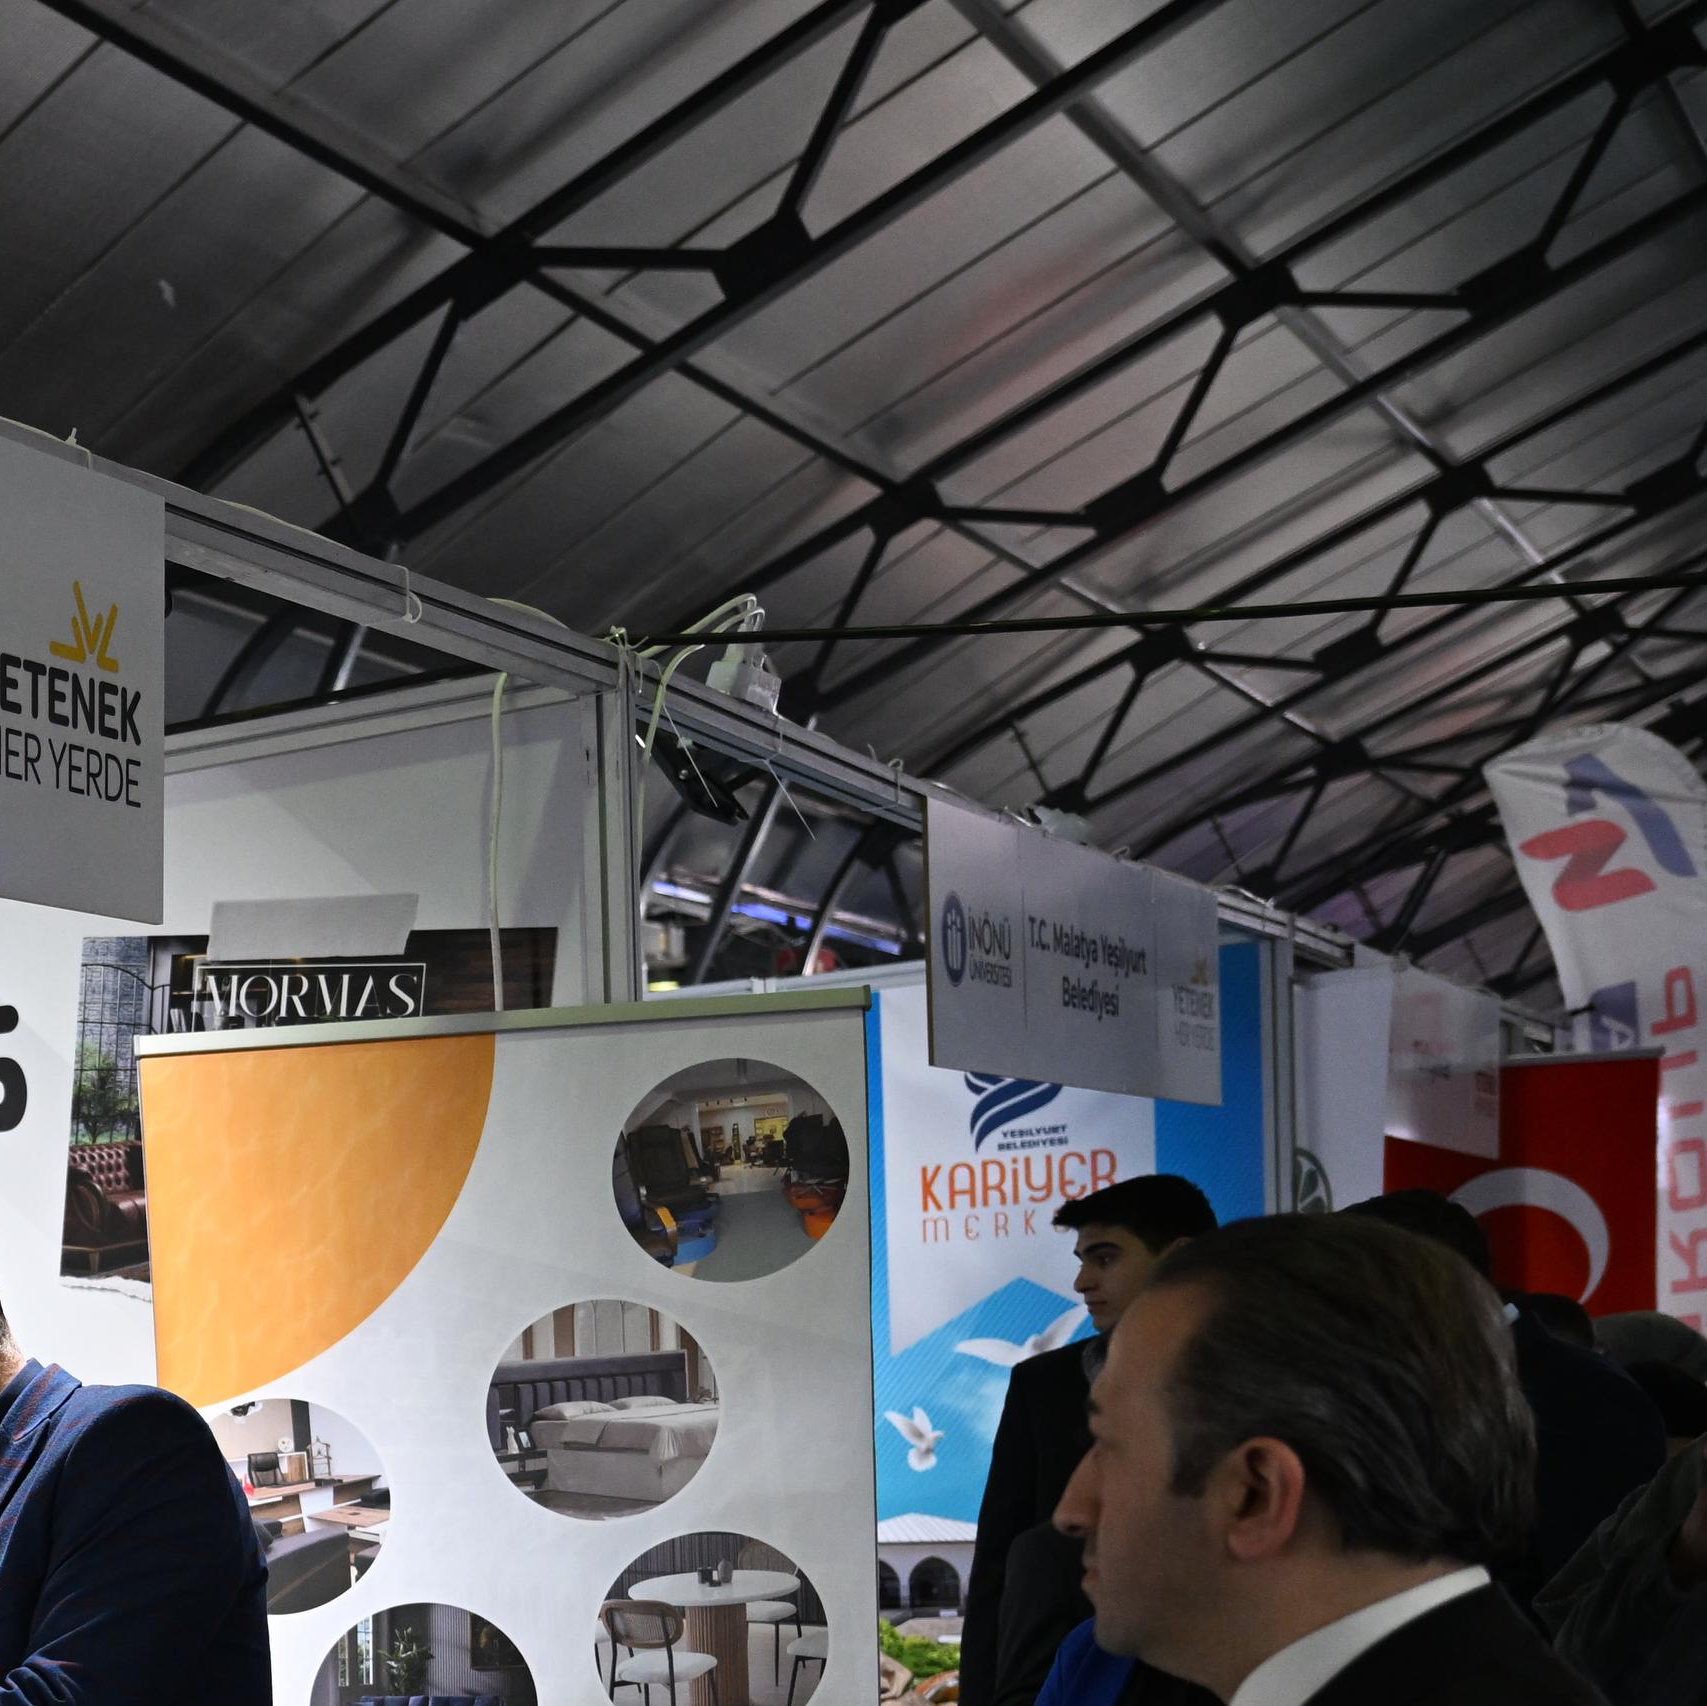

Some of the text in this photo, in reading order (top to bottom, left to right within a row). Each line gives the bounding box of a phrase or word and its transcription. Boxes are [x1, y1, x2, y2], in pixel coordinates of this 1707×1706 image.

[48, 738, 141, 808] YERDE
[968, 907, 1011, 961] İNÖNÜ
[1028, 915, 1051, 952] T.C.
[1053, 924, 1098, 969] Malatya
[1062, 976, 1120, 1022] Belediyesi
